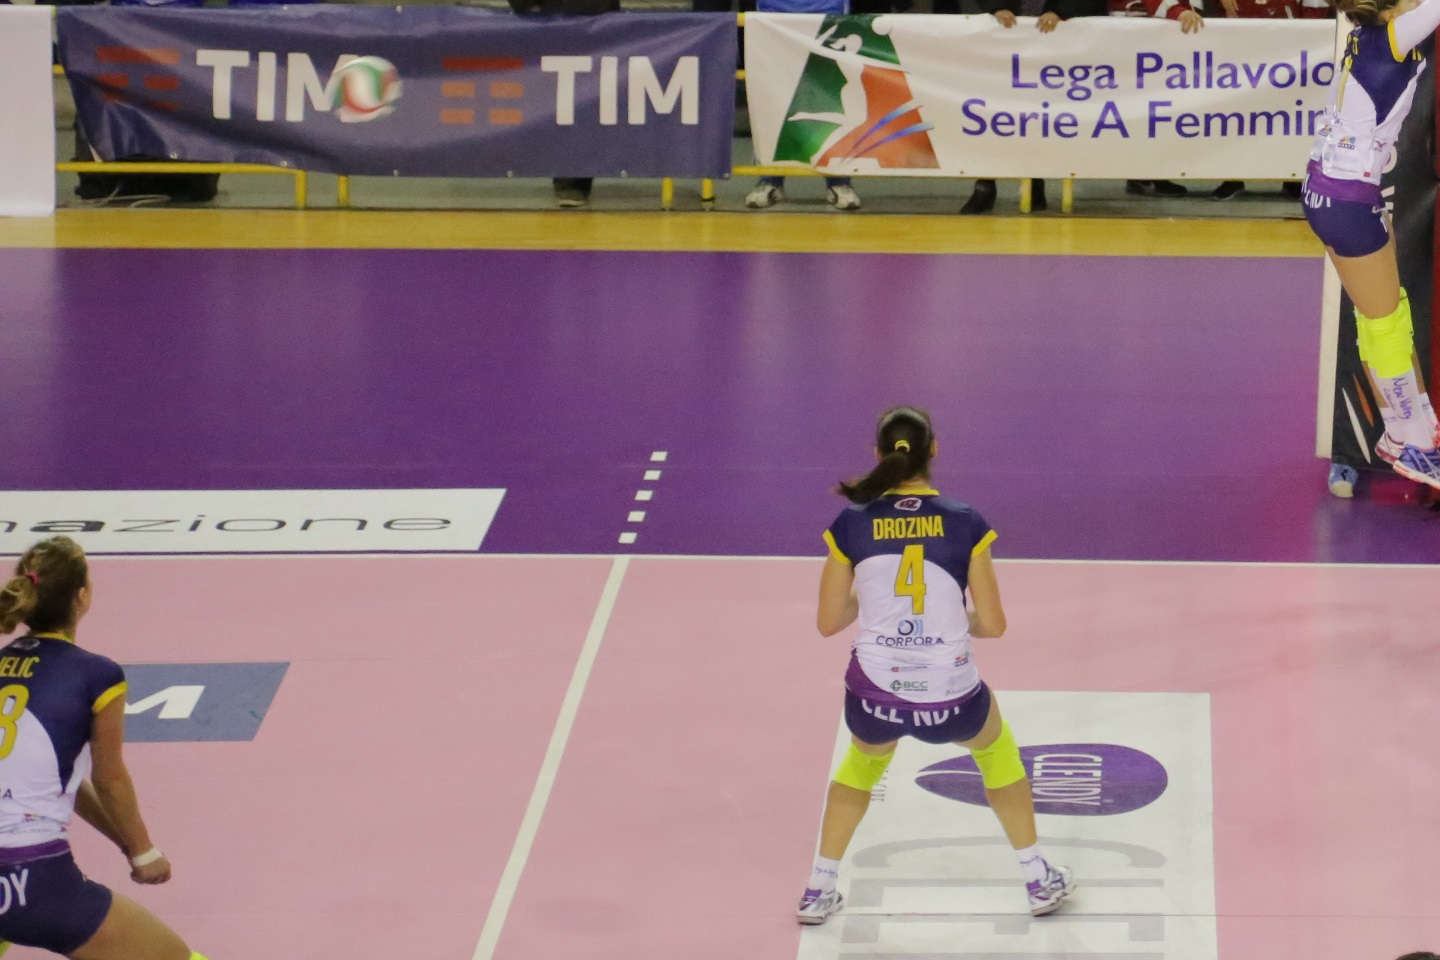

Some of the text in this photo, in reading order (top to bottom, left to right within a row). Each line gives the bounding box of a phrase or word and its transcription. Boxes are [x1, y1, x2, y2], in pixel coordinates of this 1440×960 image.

[540, 56, 699, 125] TIM
[1011, 50, 1336, 100] Lega Pallavolo
[961, 99, 1082, 138] Serie
[1091, 101, 1129, 138] A
[873, 516, 944, 540] DROZINA
[894, 544, 926, 615] 4
[876, 635, 944, 647] CORPORA
[903, 681, 928, 689] BCC
[1032, 753, 1103, 806] CLENDY
